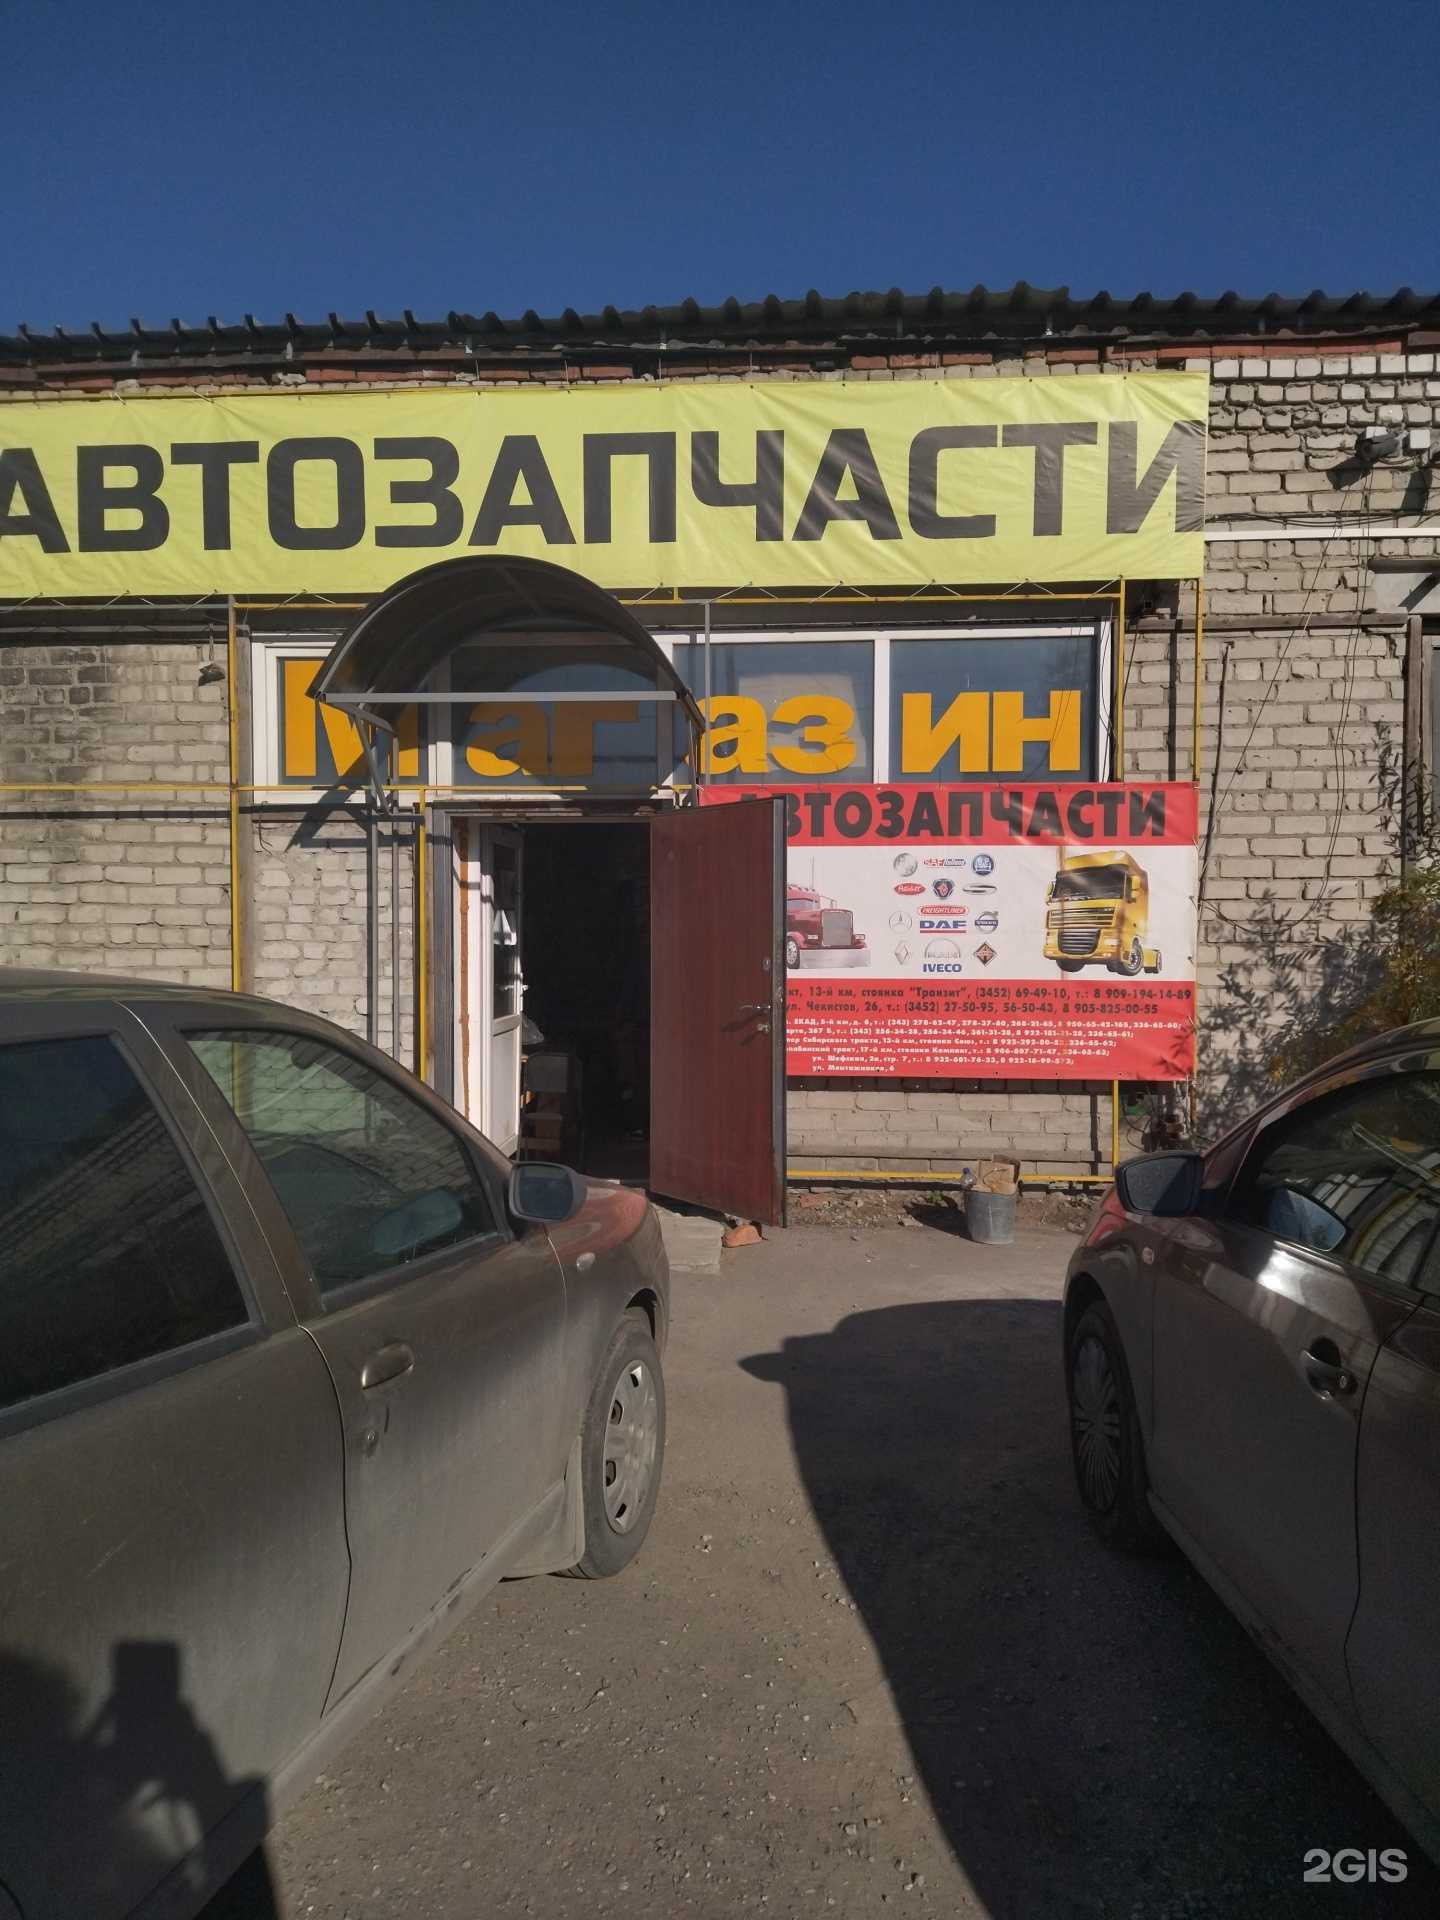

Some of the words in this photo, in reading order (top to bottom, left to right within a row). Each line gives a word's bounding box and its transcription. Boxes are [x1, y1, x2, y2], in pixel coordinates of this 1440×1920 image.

[0, 419, 1206, 554] АВТОЗАПЧАСТИ
[740, 790, 1166, 839] ВТОЗАПЧАСТИ
[919, 920, 967, 929] DAF
[922, 963, 962, 973] IVECO
[976, 986, 1011, 999] (3452)
[1094, 988, 1101, 999] 8
[905, 1001, 940, 1014] (3452)
[1062, 1003, 1070, 1014] 8
